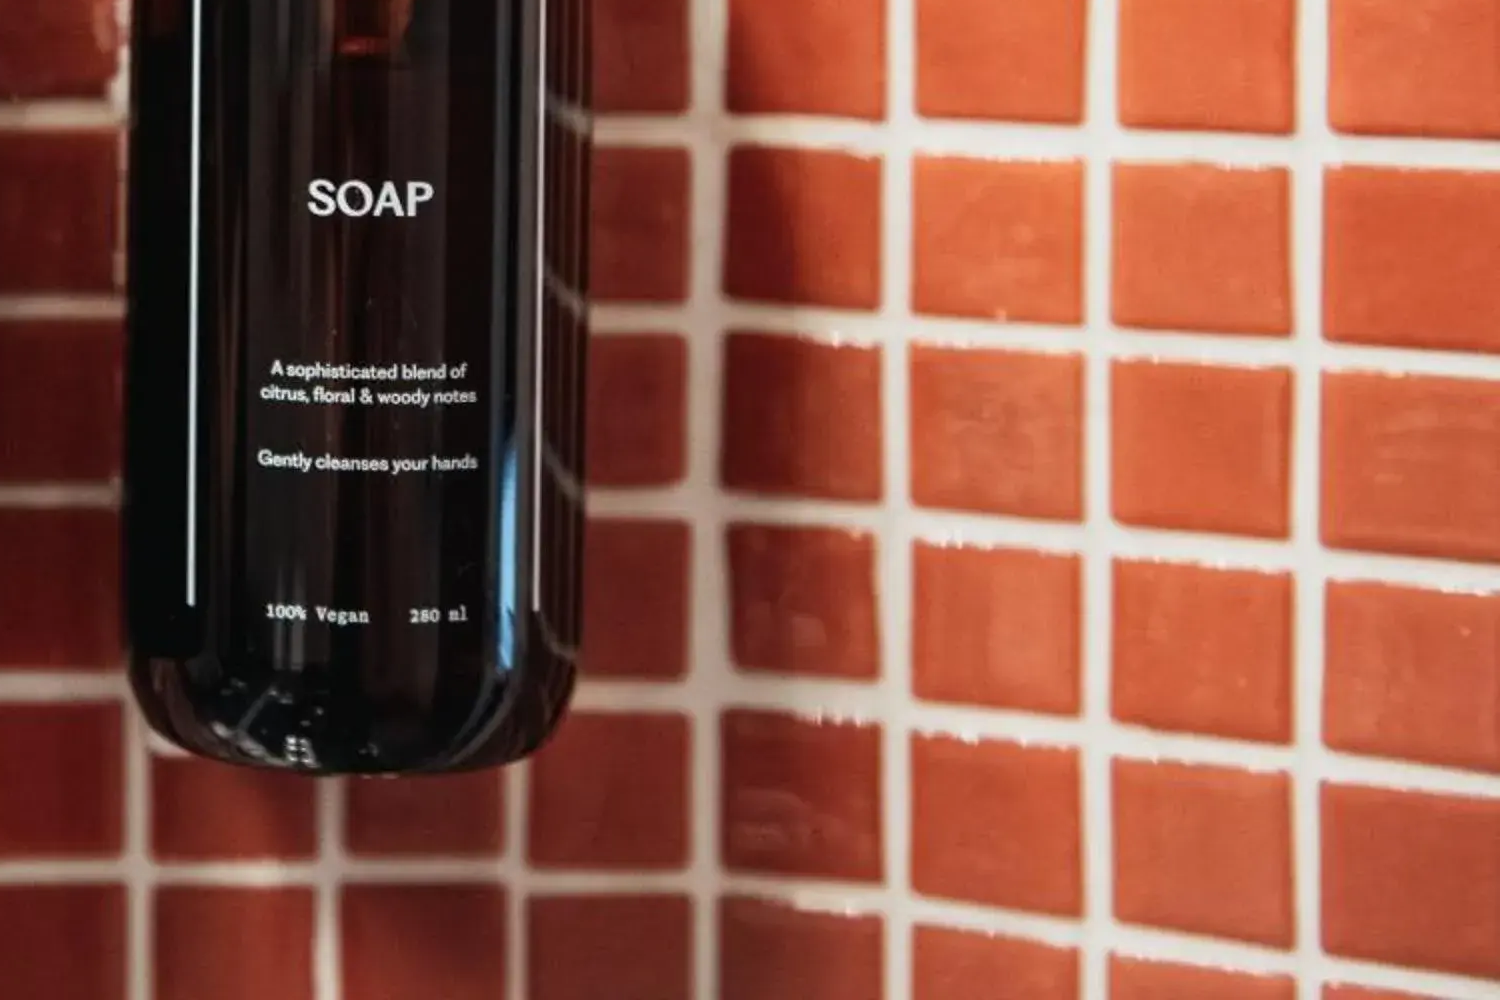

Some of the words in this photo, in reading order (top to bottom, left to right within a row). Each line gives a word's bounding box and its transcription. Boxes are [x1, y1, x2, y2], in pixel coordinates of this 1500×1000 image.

[307, 178, 435, 217] SOAP
[270, 359, 285, 377] A
[285, 361, 399, 382] sophisticated
[401, 363, 447, 381] blend
[449, 361, 468, 380] of
[259, 383, 311, 404] citrus,
[312, 385, 356, 404] floral
[358, 386, 374, 405] &
[376, 387, 431, 409] woody
[432, 389, 478, 405] notes
[257, 448, 313, 473] Gently
[314, 452, 390, 472] cleanses
[391, 458, 429, 476] your
[430, 453, 479, 471] hands
[266, 603, 307, 621] 100%
[314, 605, 370, 626] Vegan
[409, 607, 441, 624] 280
[448, 604, 468, 622] ml
